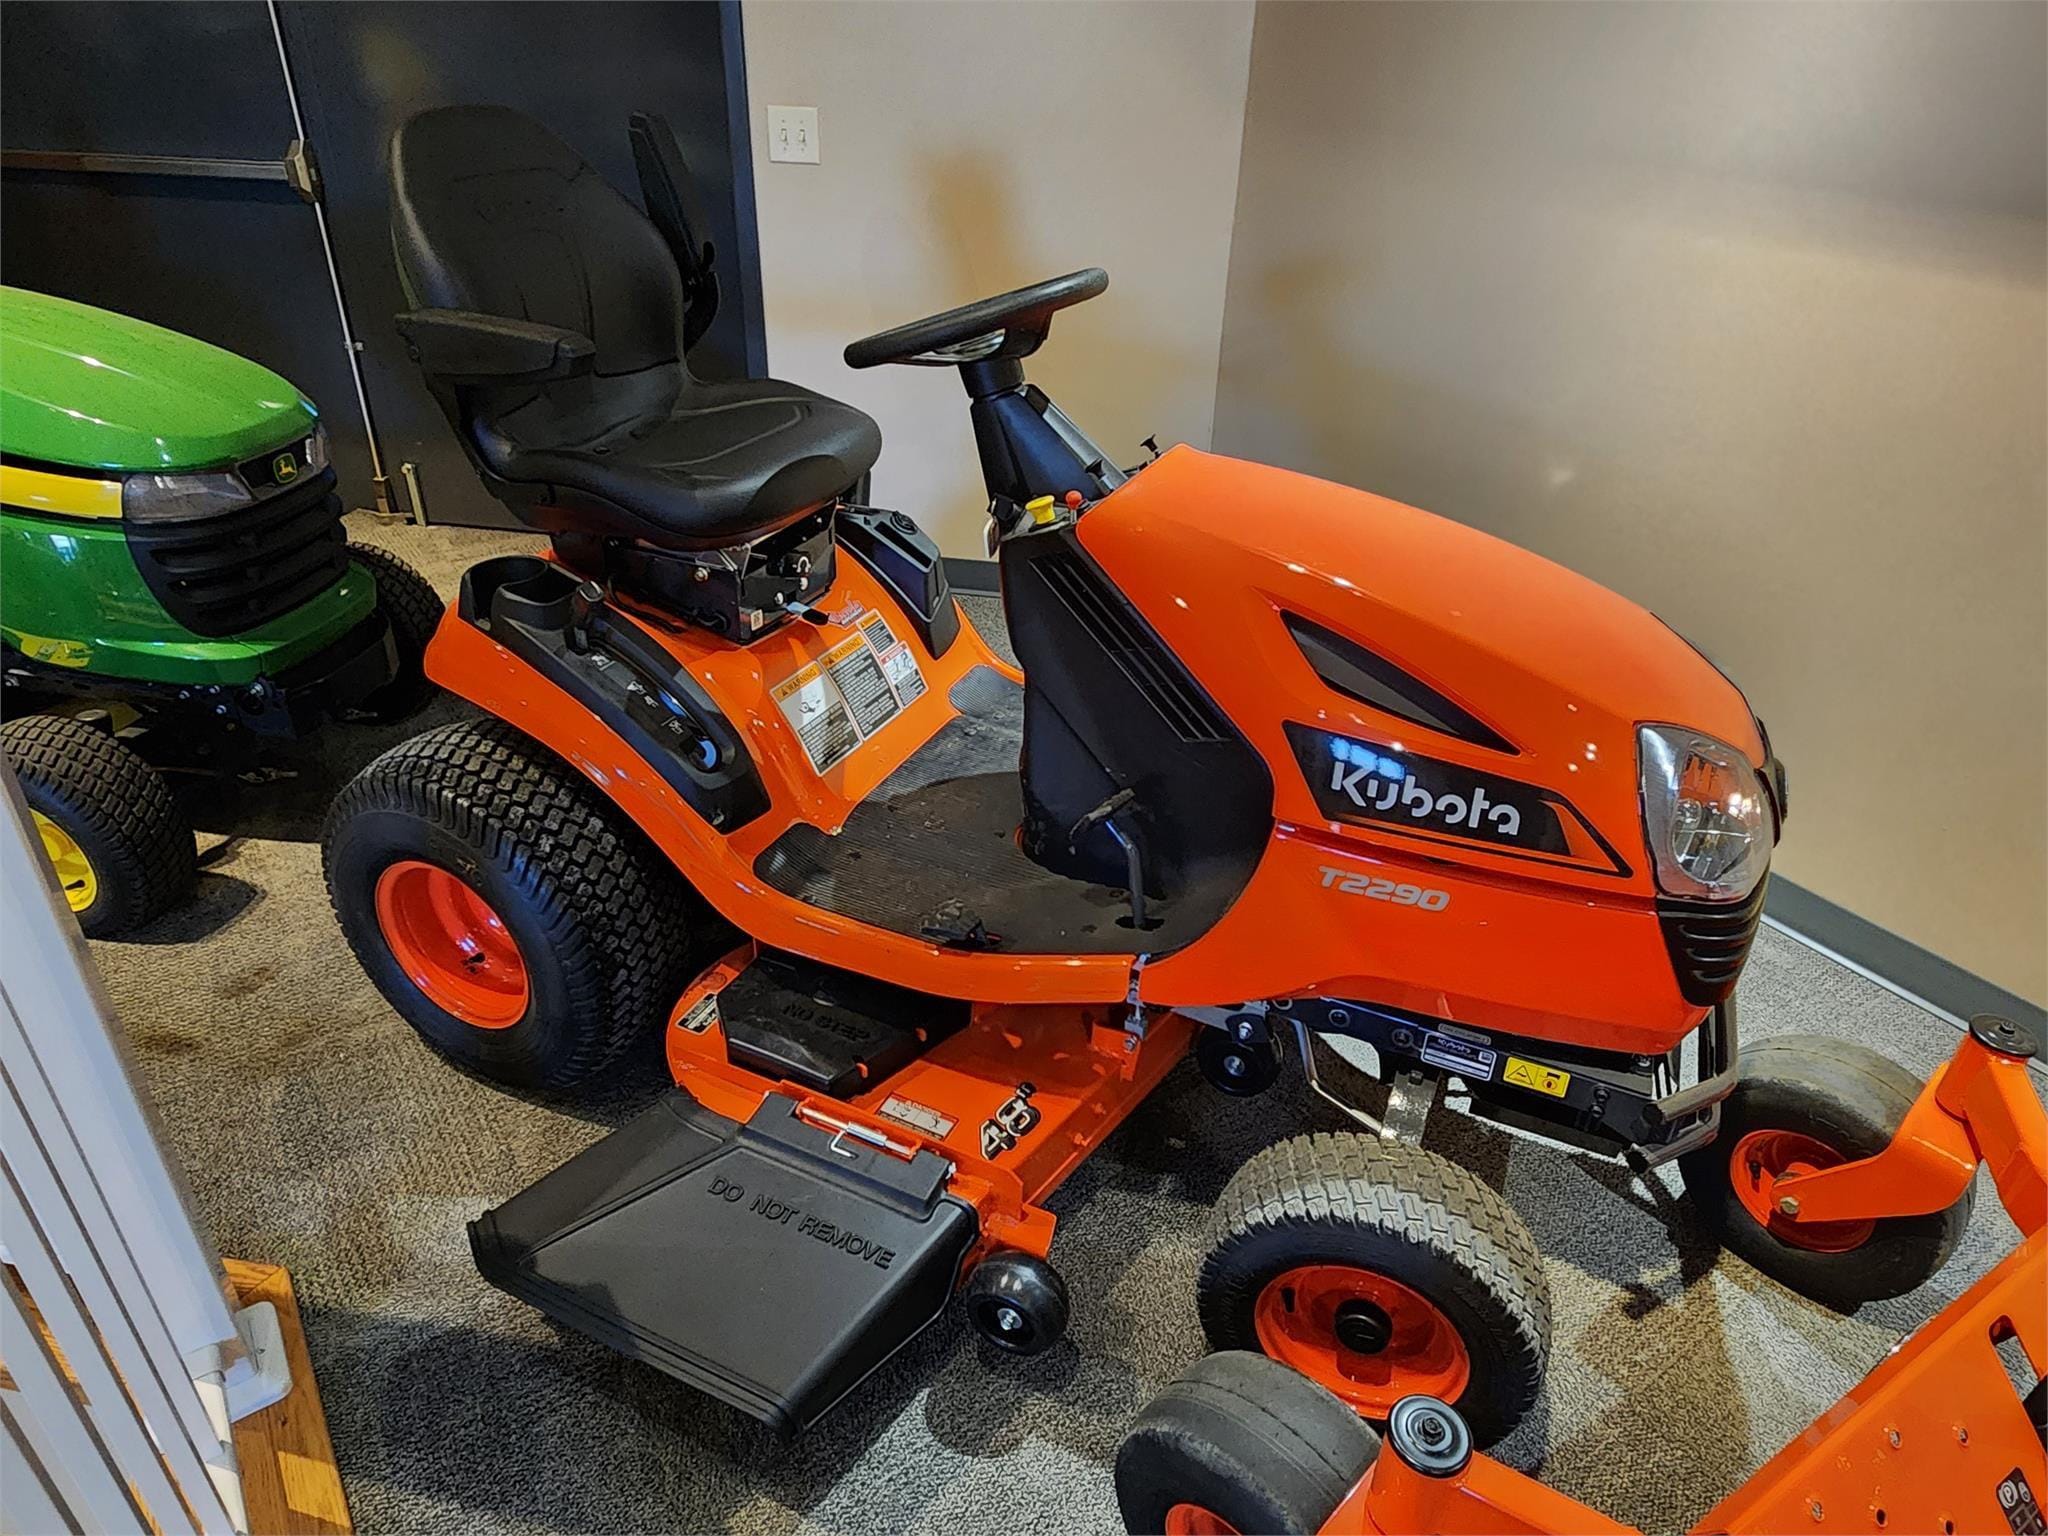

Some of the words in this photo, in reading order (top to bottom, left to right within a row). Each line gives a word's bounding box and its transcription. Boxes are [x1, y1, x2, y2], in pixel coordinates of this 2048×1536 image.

[787, 668, 818, 692] WARNING
[1330, 761, 1521, 836] Kubota
[1319, 866, 1450, 911] T2290
[783, 1003, 813, 1022] NO
[707, 1176, 744, 1203] DO
[750, 1194, 799, 1224] NOT
[798, 1214, 896, 1269] REMOVE
